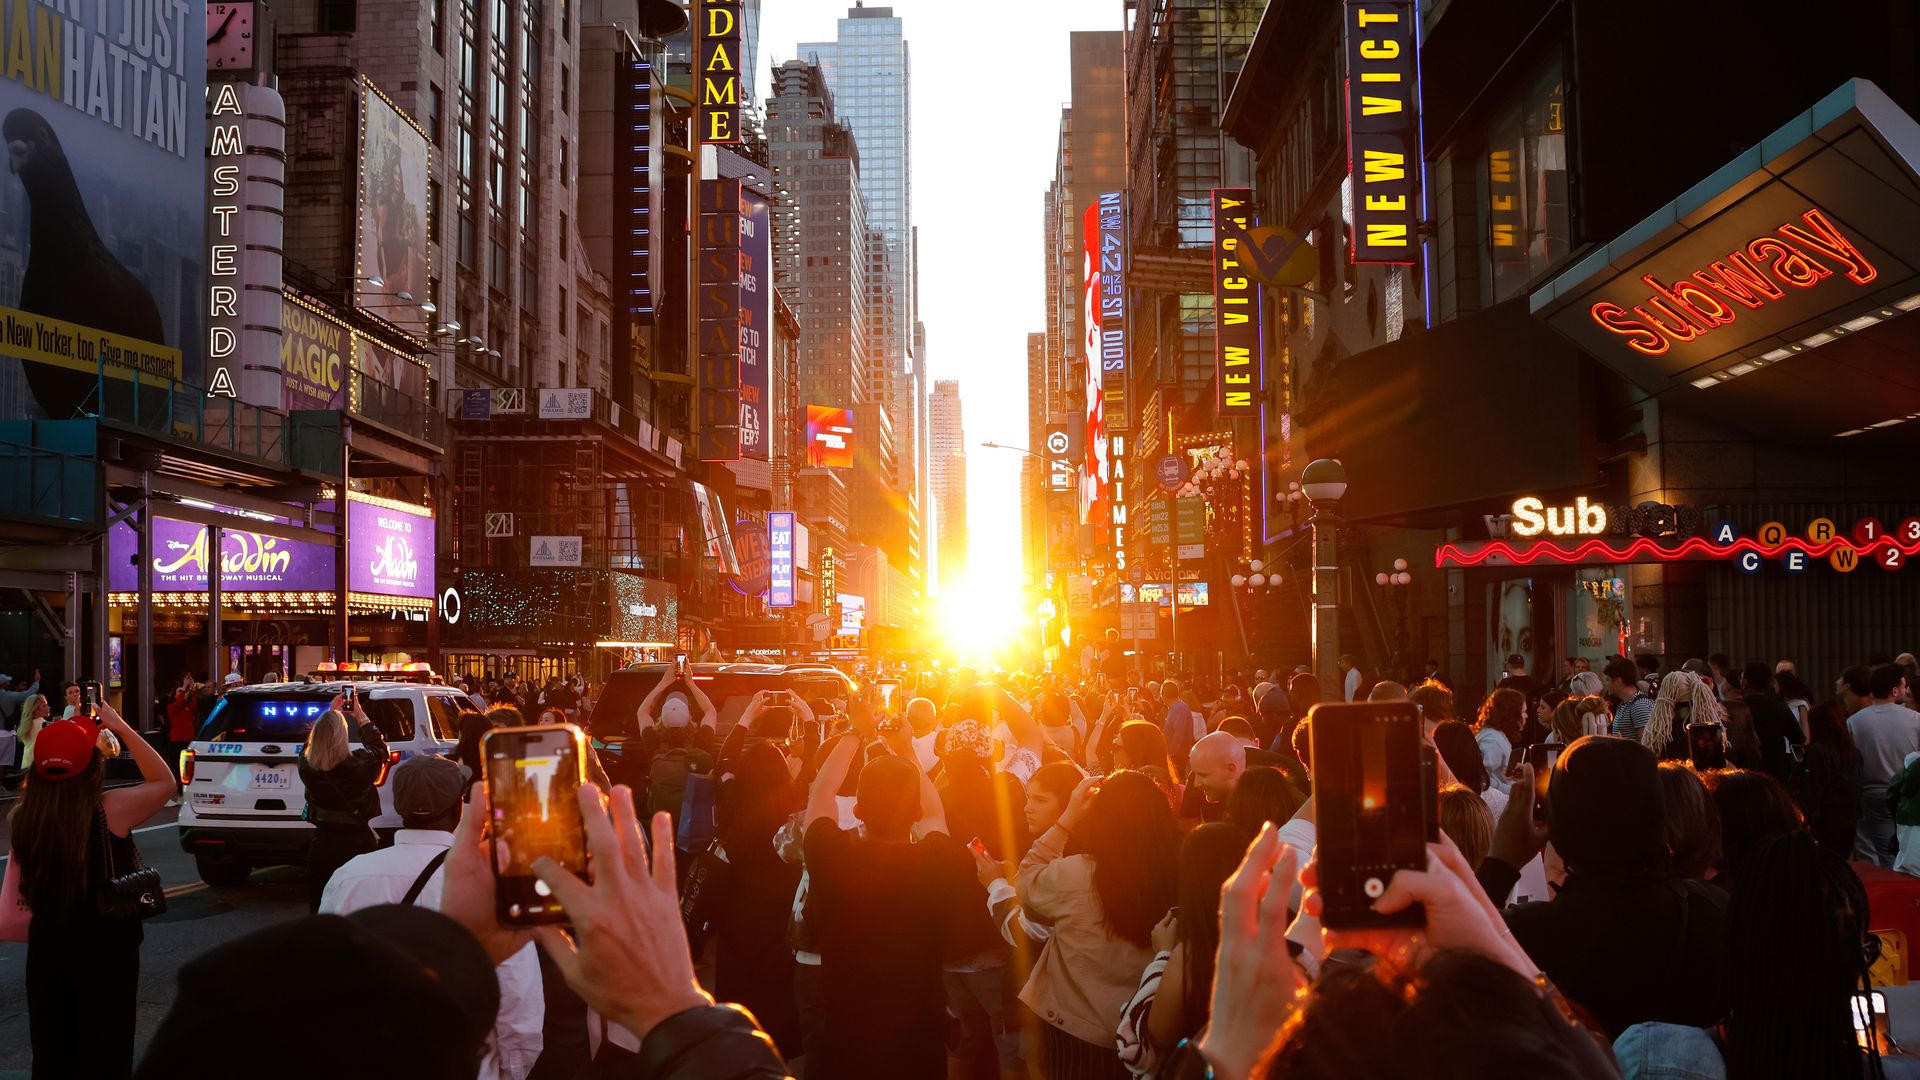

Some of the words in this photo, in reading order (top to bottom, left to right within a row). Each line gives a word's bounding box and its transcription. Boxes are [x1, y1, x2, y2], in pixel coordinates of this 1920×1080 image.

[216, 5, 226, 15] 12
[0, 0, 187, 158] ANHATTAN
[703, 0, 736, 140] DAME
[739, 197, 753, 217] EW
[1364, 150, 1407, 246] NEW
[1100, 193, 1120, 230] NEW
[740, 216, 754, 238] ENU
[739, 252, 753, 272] EW
[740, 271, 756, 293] MES
[1590, 208, 1877, 356] Subway
[282, 303, 340, 352] ROADWAY
[740, 309, 753, 327] EW
[7, 315, 33, 349] New
[36, 321, 75, 360] Yorker,
[77, 331, 97, 363] too.
[750, 328, 759, 348] TO
[281, 333, 341, 392] MAGIC
[286, 377, 298, 390] JUST
[303, 383, 317, 397] WISH
[1225, 346, 1251, 406] NEW
[1113, 436, 1126, 570] HAIMES
[377, 516, 403, 531] WELCOME
[404, 523, 412, 533] TO
[1718, 525, 1734, 542] A
[1764, 526, 1781, 545] Q
[1816, 523, 1830, 540] R
[1865, 522, 1873, 539] 1
[1908, 521, 1920, 539] 3
[772, 531, 790, 545] EAT
[772, 564, 790, 574] PLAY
[1742, 553, 1758, 570] C
[1789, 553, 1803, 570] E
[1836, 550, 1853, 568] W
[1886, 548, 1899, 566] 2
[1154, 570, 1200, 580] VICORY
[1072, 593, 1089, 605] 25
[208, 743, 243, 753] NYPD
[255, 773, 279, 783] 4420
